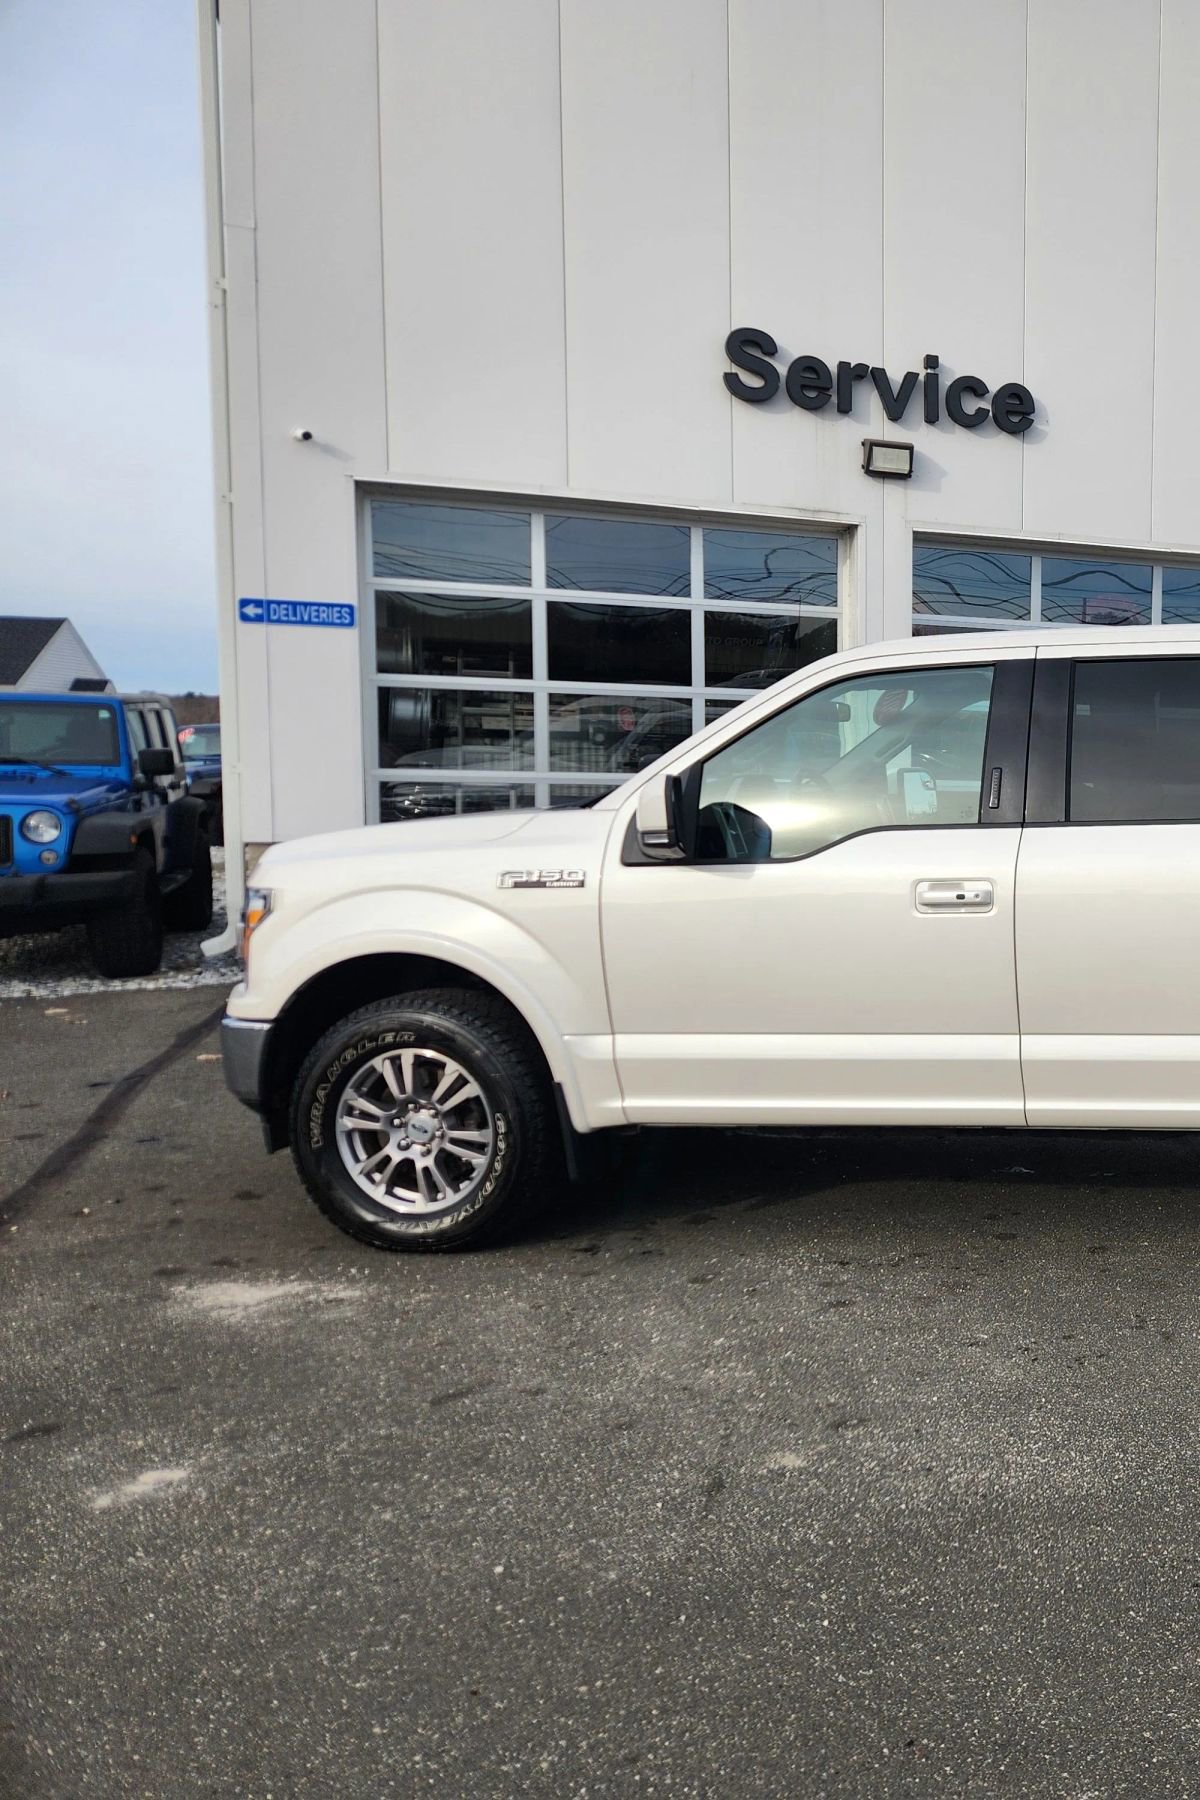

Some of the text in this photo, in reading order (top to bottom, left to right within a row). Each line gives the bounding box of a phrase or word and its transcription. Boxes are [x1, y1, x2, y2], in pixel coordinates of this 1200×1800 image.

[723, 327, 1036, 434] Service
[269, 603, 351, 624] DELIVERIES
[310, 1031, 416, 1149] WRANGLER
